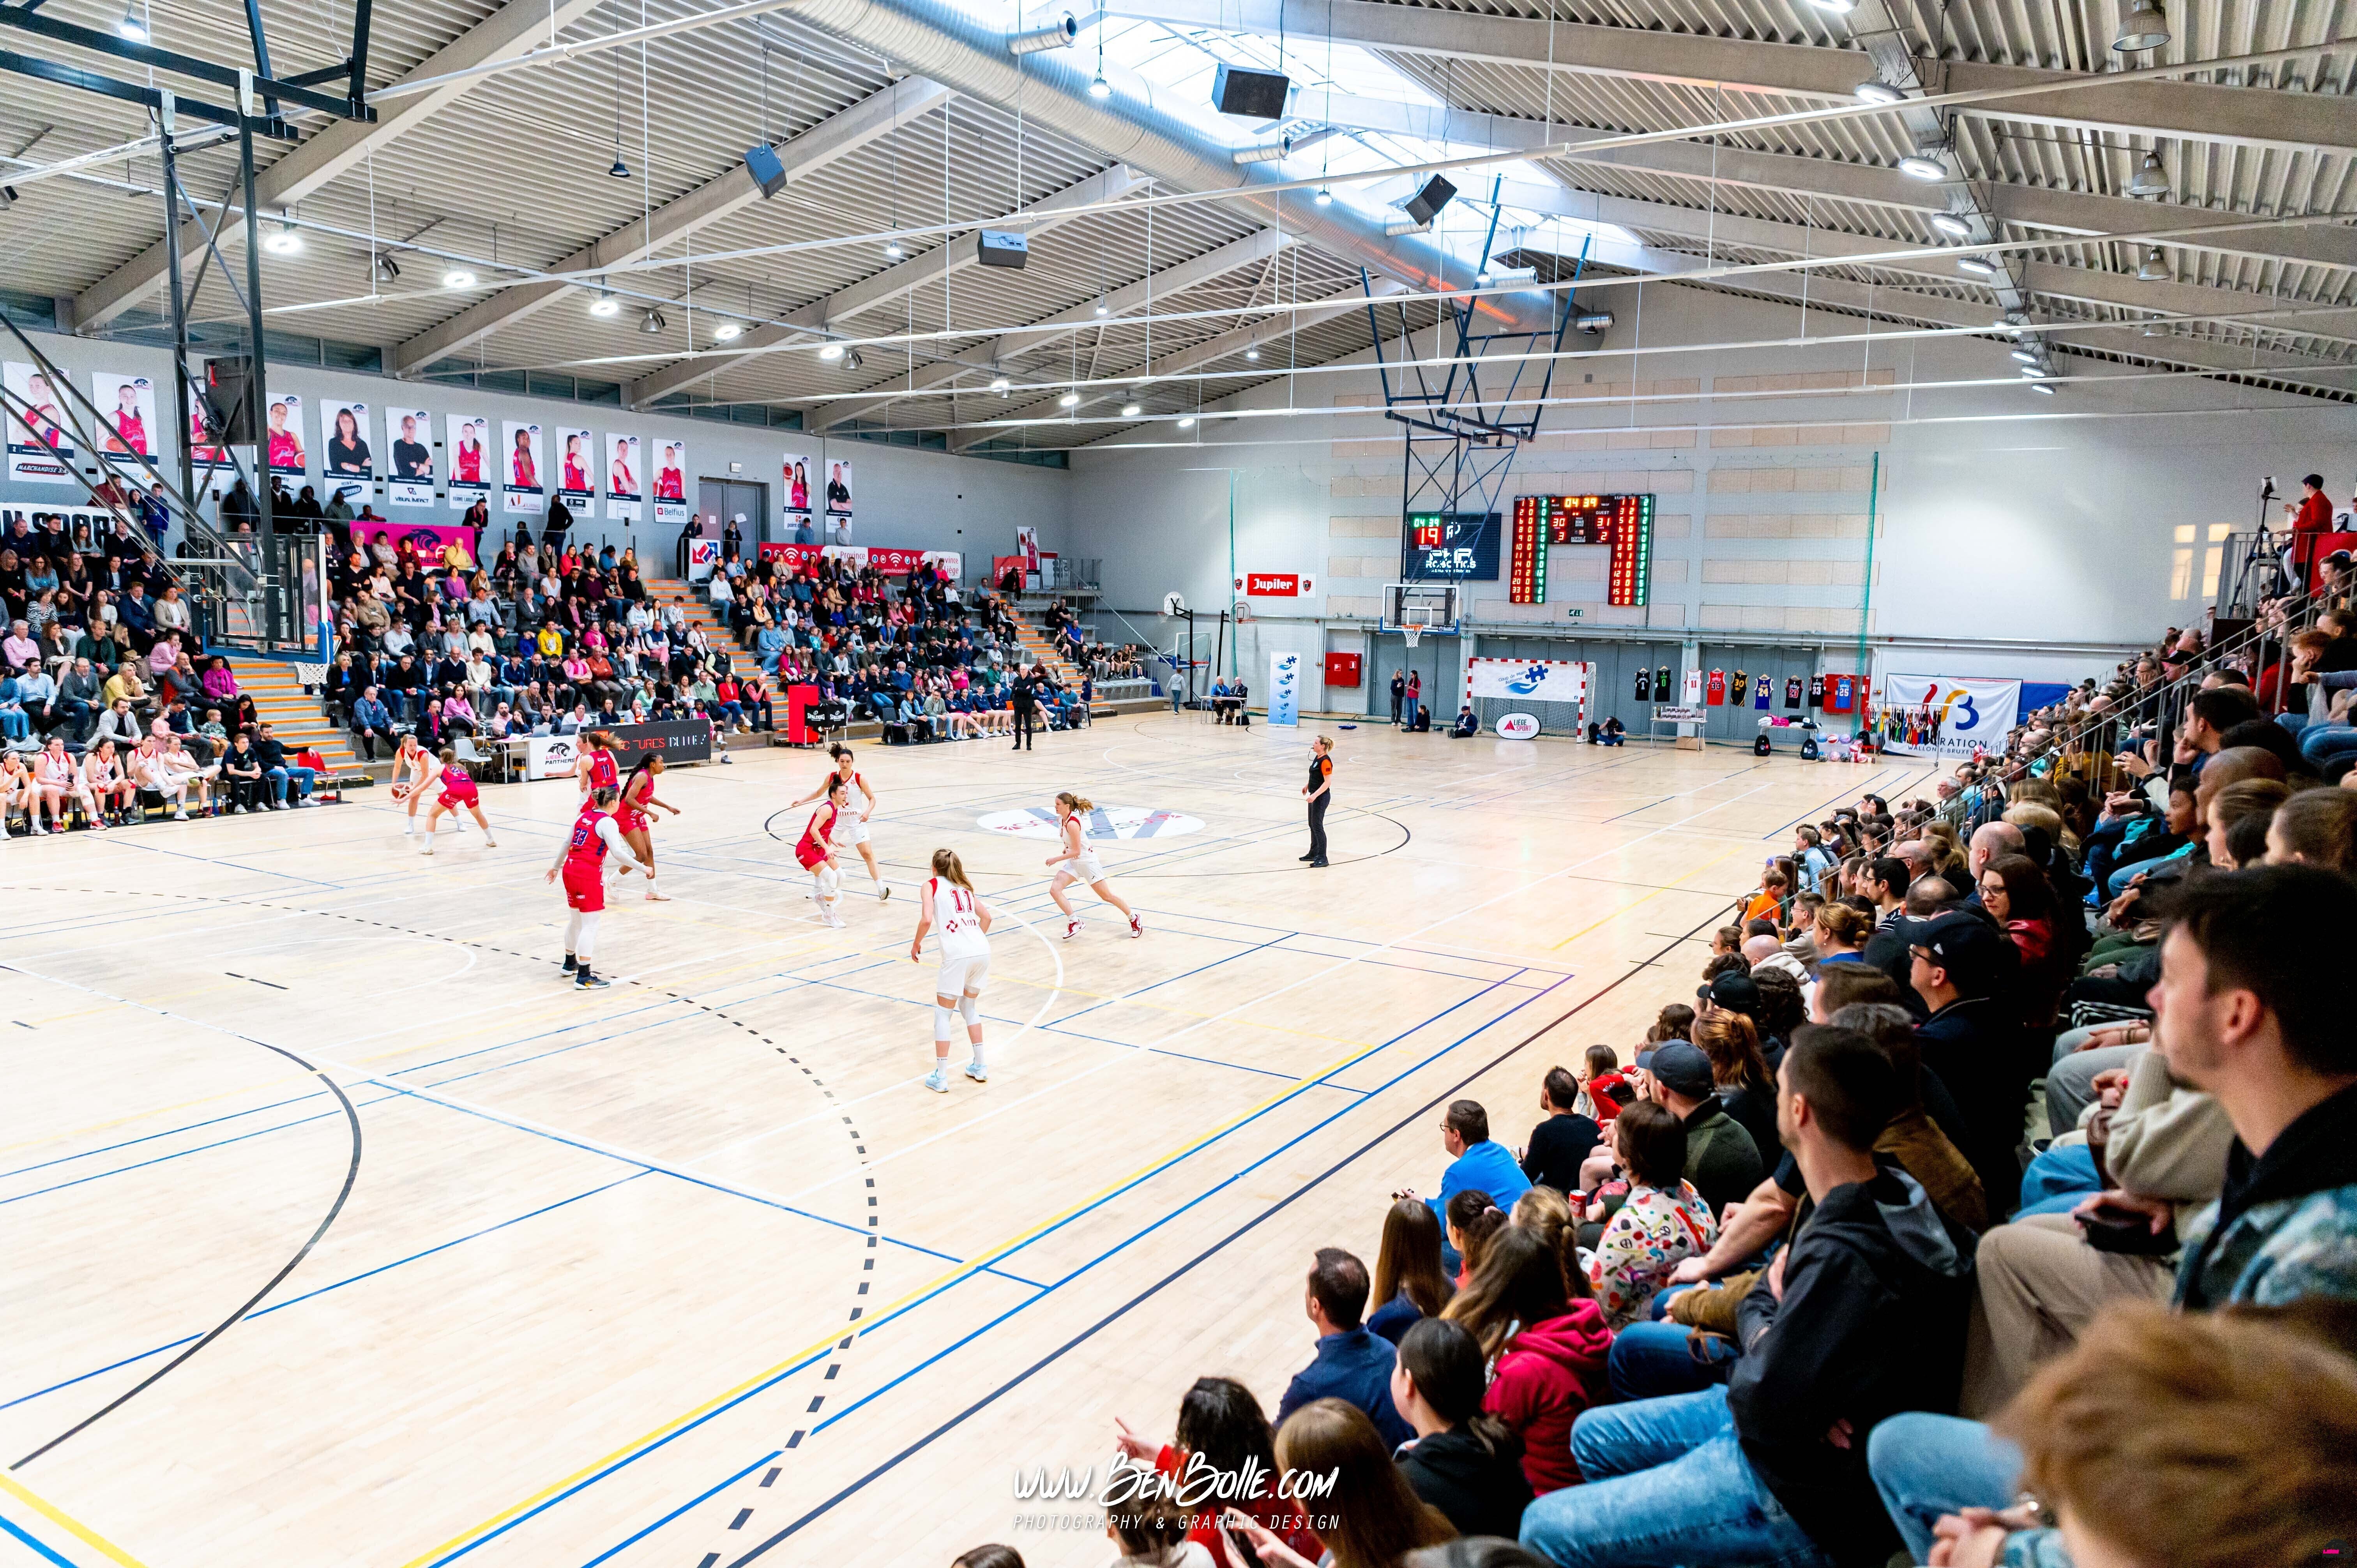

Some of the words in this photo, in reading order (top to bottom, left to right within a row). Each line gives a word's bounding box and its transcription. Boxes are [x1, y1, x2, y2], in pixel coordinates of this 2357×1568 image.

[18, 464, 57, 473] MARCHANDISE
[1565, 498, 1579, 508] 04
[1583, 497, 1597, 508] 39
[664, 508, 684, 516] Belfius
[1414, 518, 1425, 527] 04
[1429, 518, 1439, 527] 39
[1553, 518, 1565, 526] 30
[1597, 517, 1610, 526] 31
[1642, 516, 1648, 524] 2
[1421, 528, 1438, 544] 19
[1558, 531, 1564, 540] 3
[1601, 531, 1608, 540] 2
[1641, 534, 1647, 542] 0
[840, 551, 866, 560] Province
[1253, 578, 1293, 592] Jupiler
[1641, 682, 1645, 690] 1
[1662, 679, 1666, 687] 0
[1691, 680, 1697, 688] 11
[1711, 682, 1721, 690] 33
[1735, 679, 1744, 687] 30
[1758, 688, 1769, 697] 24
[1788, 689, 1799, 698] 23
[1812, 686, 1821, 695] 33
[1839, 688, 1849, 697] 25
[1927, 737, 1987, 748] RATION
[1908, 745, 1974, 755] WALLONE-BRUXEL
[601, 764, 611, 778] 11
[572, 828, 589, 846] 33
[950, 888, 974, 913] 11
